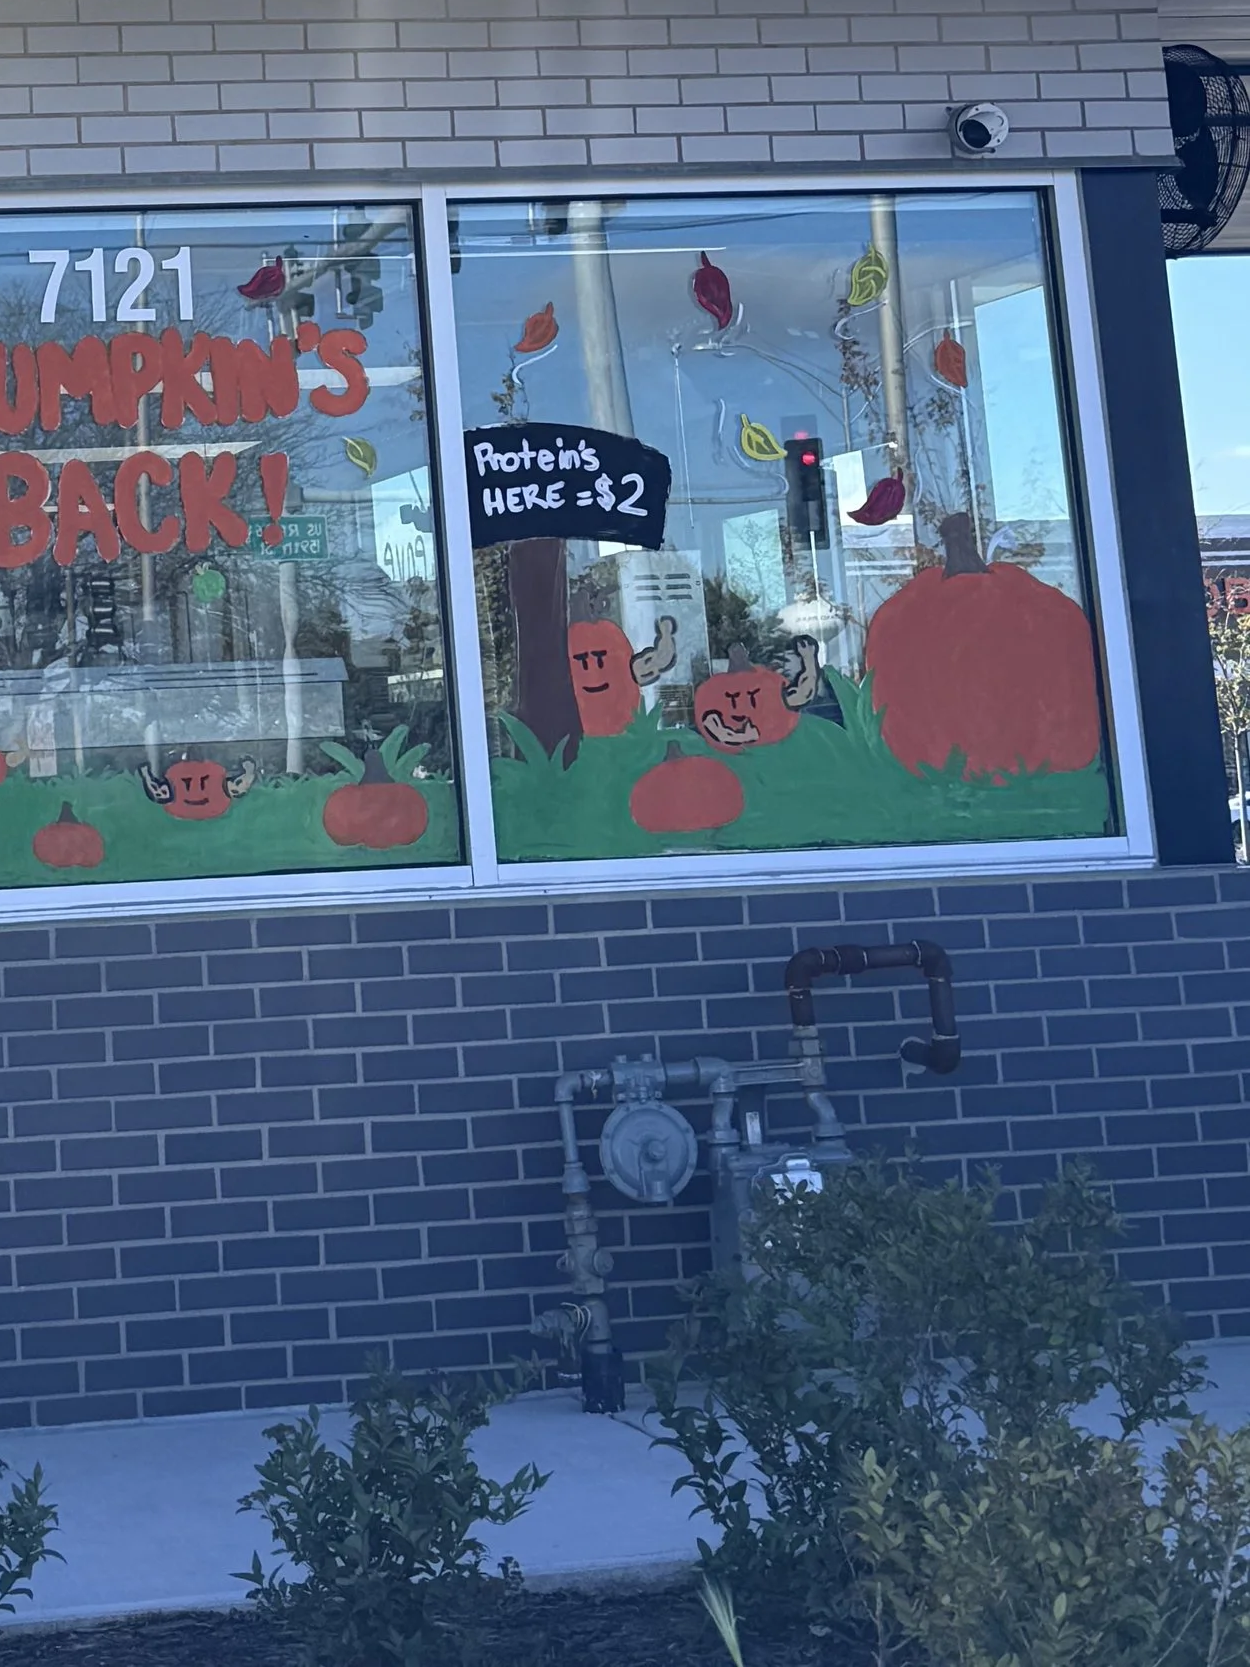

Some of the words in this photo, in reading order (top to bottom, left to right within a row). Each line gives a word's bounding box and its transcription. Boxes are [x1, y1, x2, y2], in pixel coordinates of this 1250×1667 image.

[28, 246, 194, 323] 7121
[473, 437, 600, 477] Protein's
[482, 480, 566, 517] HERE
